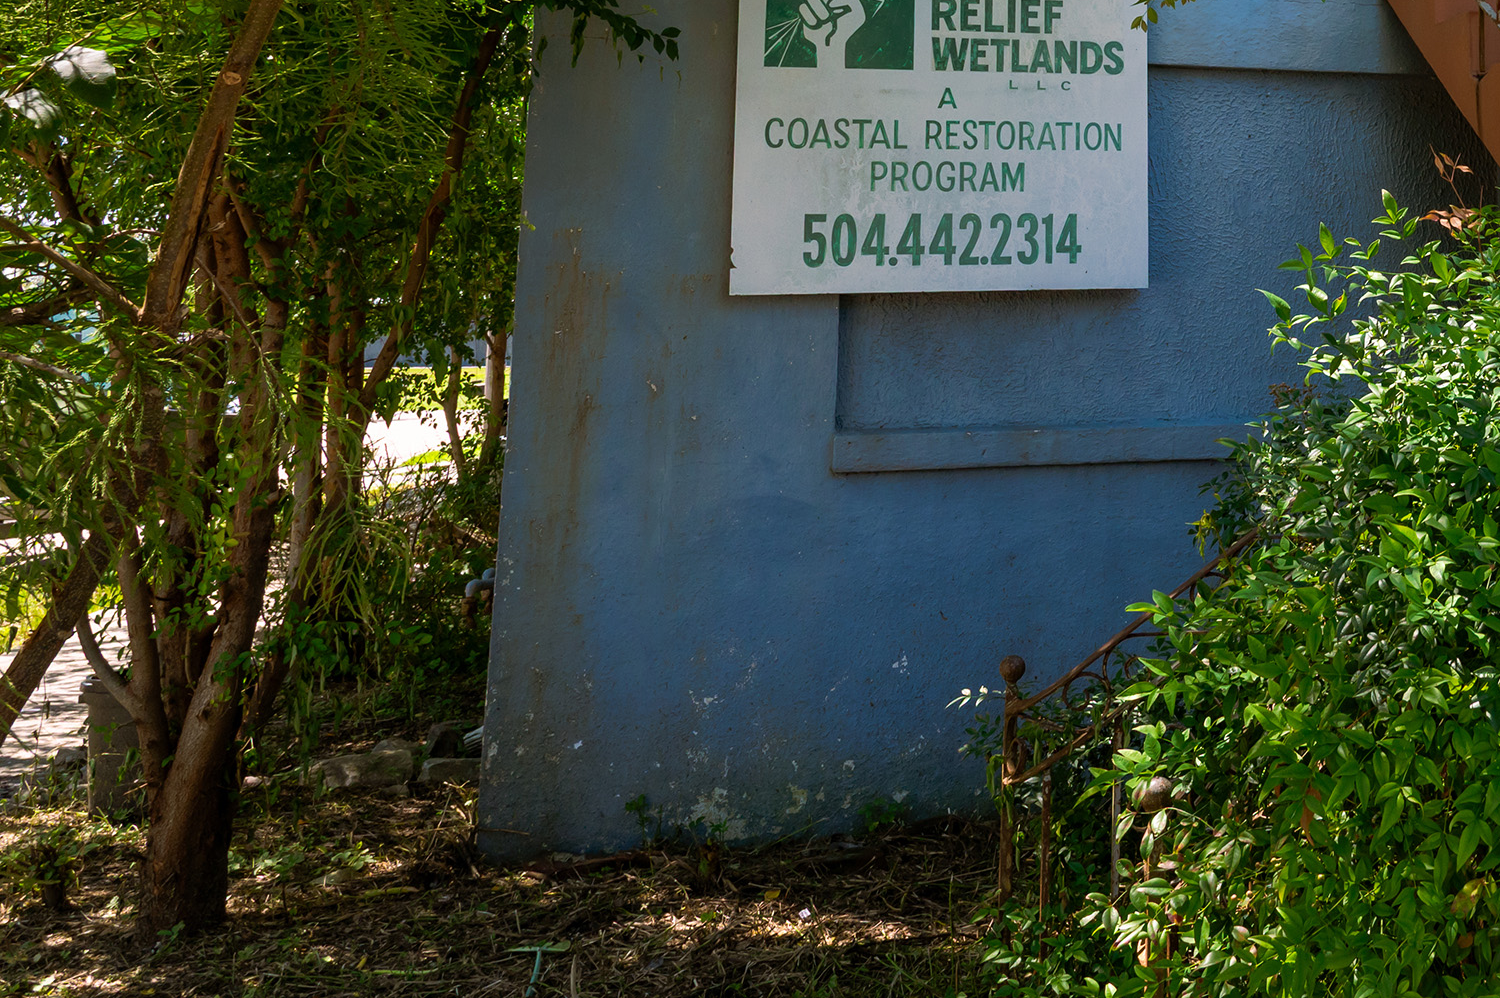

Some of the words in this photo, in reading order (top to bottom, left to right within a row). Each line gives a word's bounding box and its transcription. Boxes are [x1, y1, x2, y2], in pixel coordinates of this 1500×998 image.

[931, 37, 1124, 75] WETLANDS
[937, 87, 958, 109] A
[764, 118, 908, 150] COASTAL
[924, 120, 1122, 151] RESTORATION
[870, 161, 1025, 192] PROGRAM
[802, 213, 1082, 267] 504.442.2314
